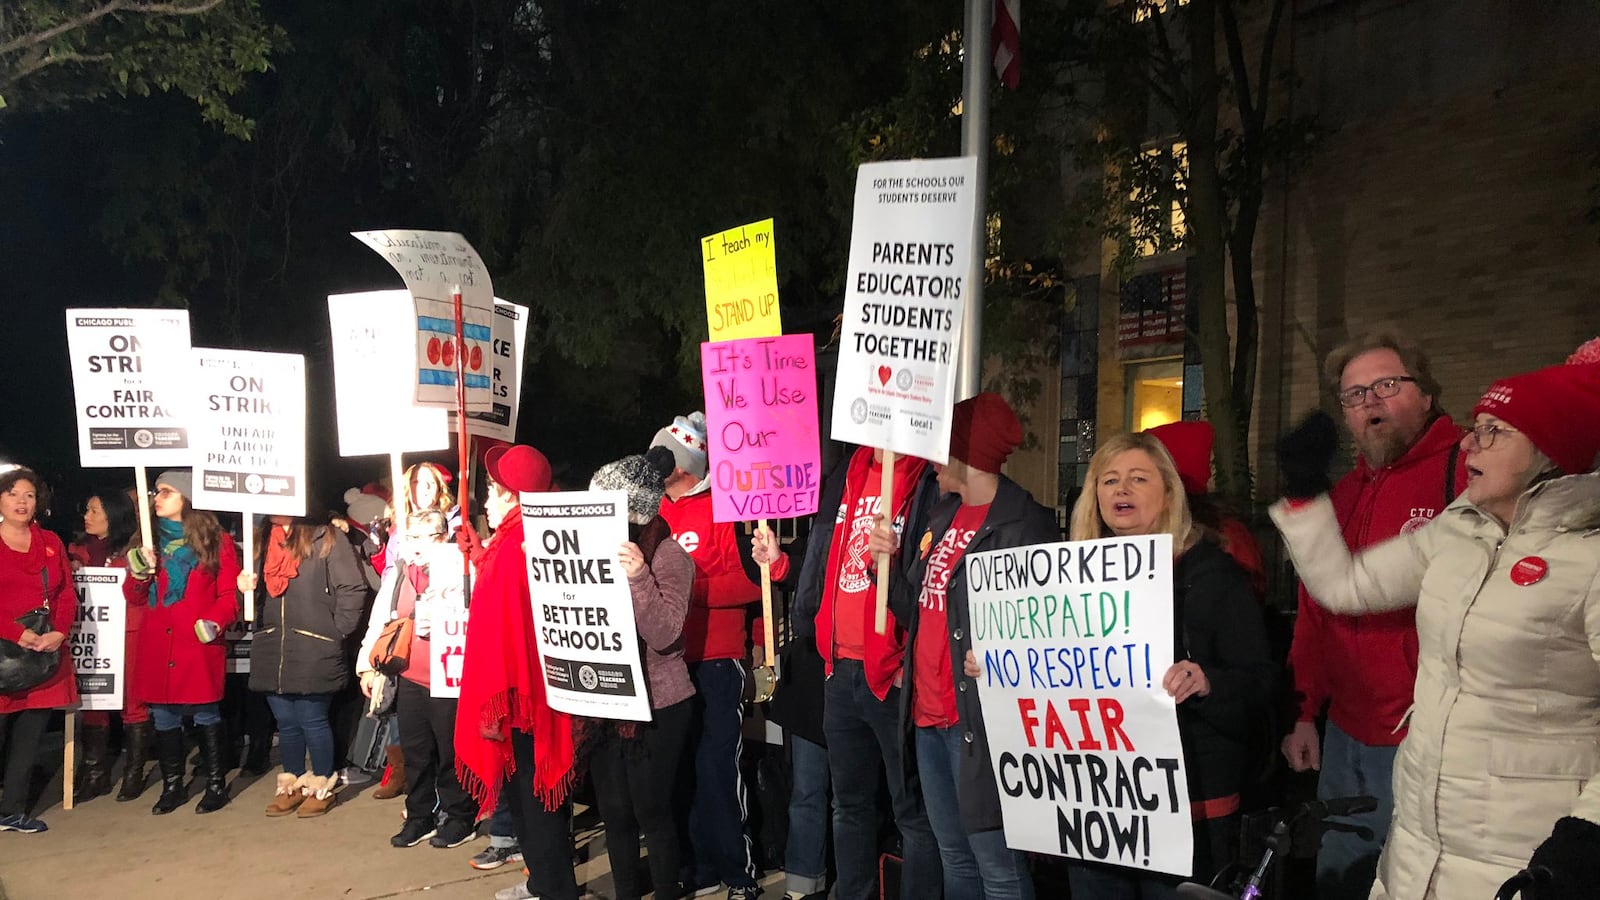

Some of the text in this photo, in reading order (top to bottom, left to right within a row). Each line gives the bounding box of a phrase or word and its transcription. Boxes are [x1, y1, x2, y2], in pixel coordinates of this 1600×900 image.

[873, 175, 965, 189] FOR THE SCHOOLS OUR
[878, 191, 957, 203] STUDENTS DESERVE
[705, 226, 770, 263] I teach my
[872, 242, 954, 267] PARENTS
[857, 272, 962, 300] EDUCATORS
[78, 318, 113, 327] CHICAGO
[713, 292, 775, 332] STAND UP
[861, 302, 952, 332] STUDENTS
[710, 340, 808, 376] It's Time
[113, 390, 154, 403] FAIR
[229, 375, 264, 393] ON
[716, 375, 806, 410] We Use
[721, 421, 777, 451] Our
[910, 416, 929, 430] Local
[543, 507, 570, 516] PUBLIC
[570, 505, 613, 516] SCHOOLS
[729, 491, 816, 516] VOICE!
[1410, 508, 1435, 518] CTU
[542, 529, 581, 555] ON
[532, 557, 614, 585] STRIKE
[969, 539, 1156, 593] OVERWORKED!
[562, 592, 576, 601] for
[542, 604, 610, 627] BETTER
[973, 590, 1131, 641] UNDERPAID!
[542, 626, 623, 652] SCHOOLS
[984, 643, 1151, 690] NO RESPECT!
[1017, 698, 1135, 752] FAIR
[998, 751, 1180, 814] CONTRACT
[1056, 805, 1151, 867] NOW!
